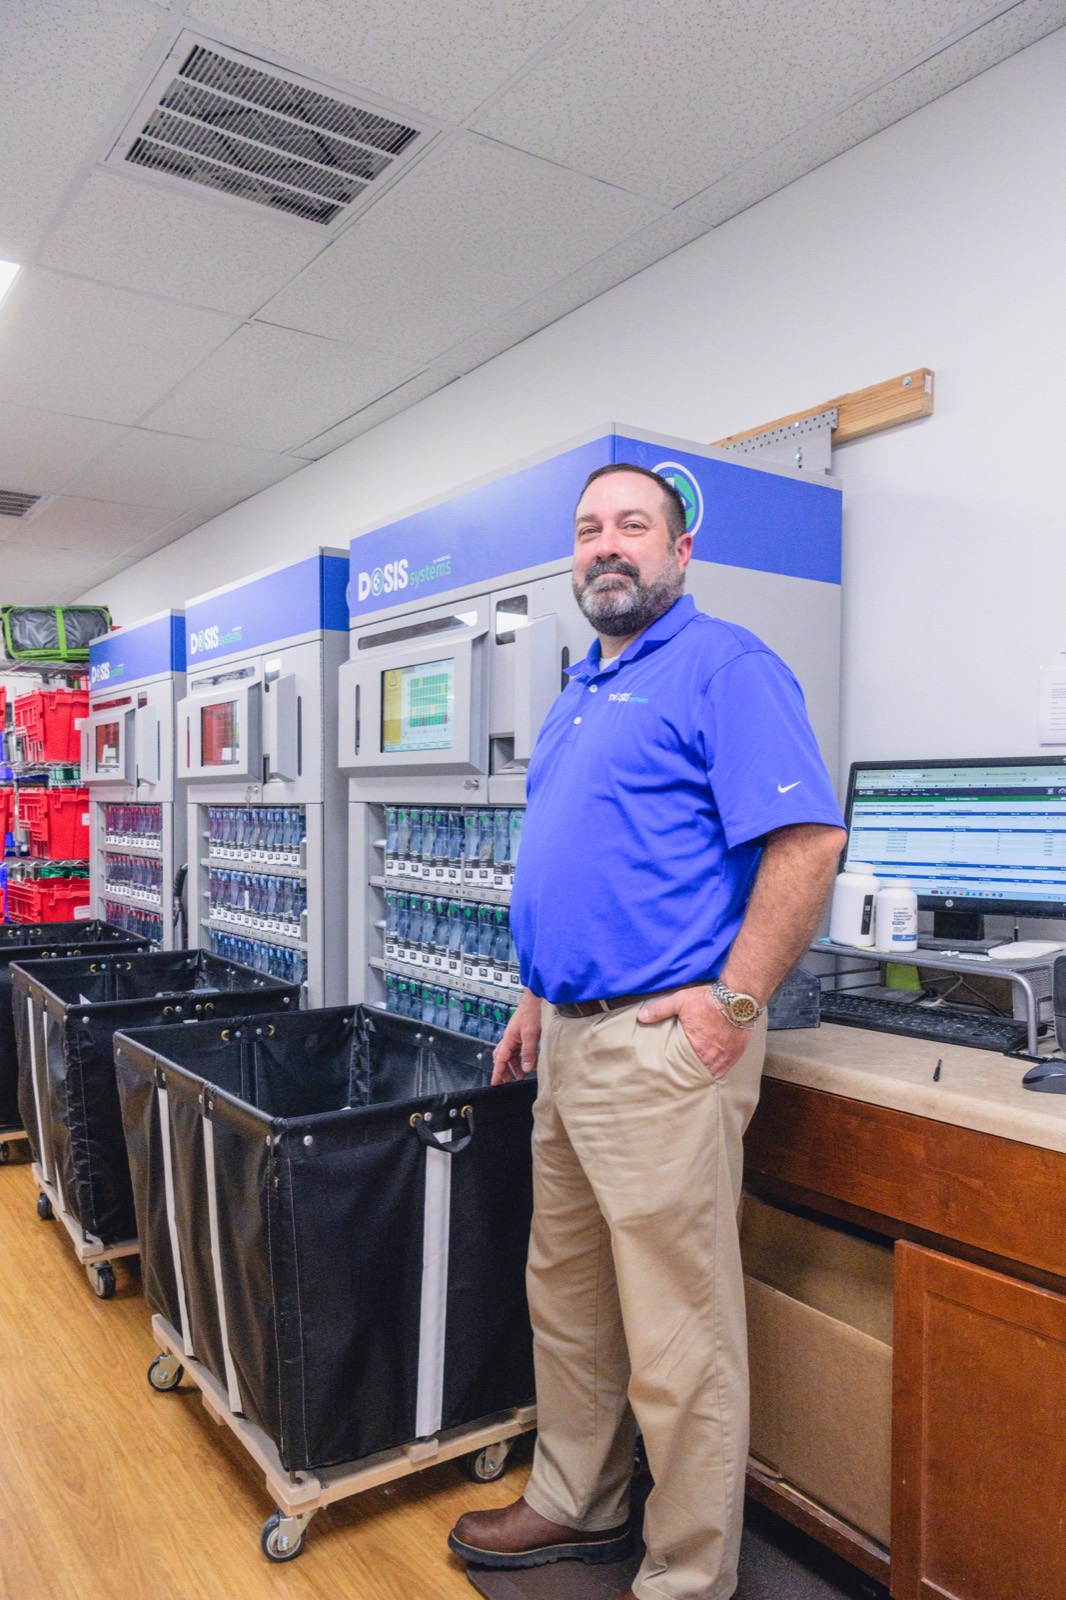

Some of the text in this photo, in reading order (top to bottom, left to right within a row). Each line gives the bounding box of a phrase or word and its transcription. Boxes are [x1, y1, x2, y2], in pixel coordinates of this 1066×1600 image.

[358, 558, 451, 601] DOSIS systems
[190, 626, 219, 655] DOSIS
